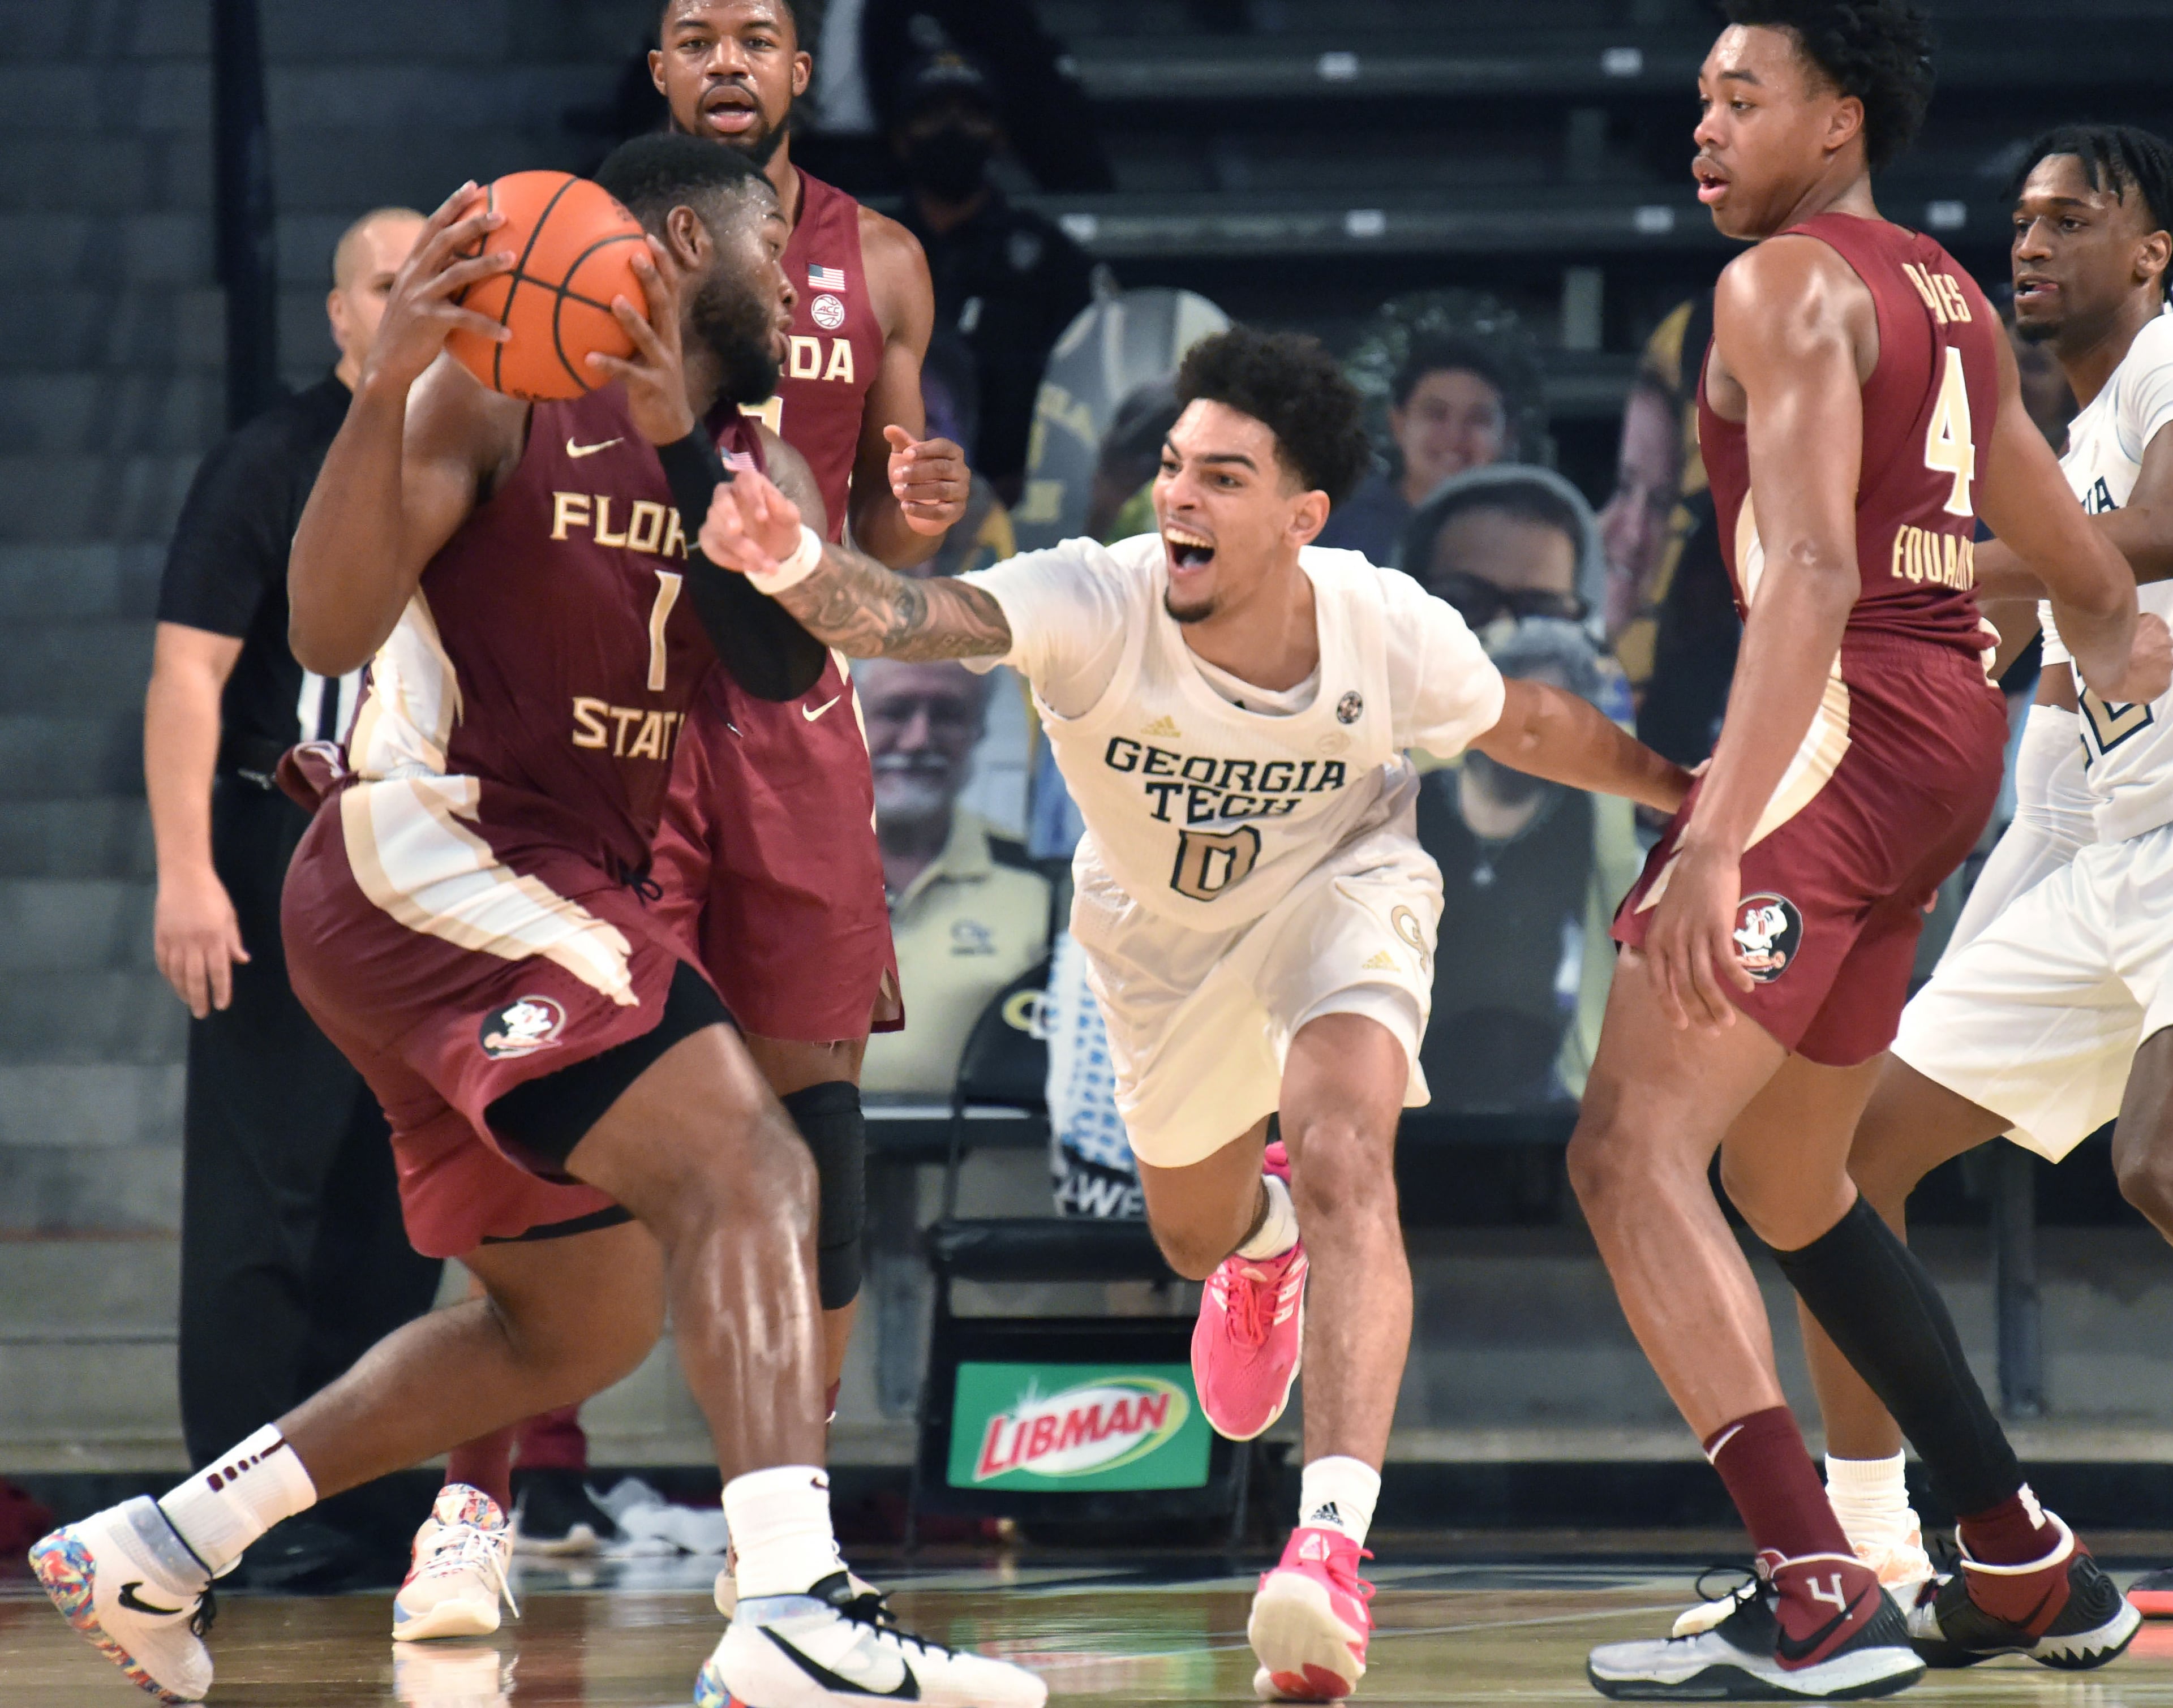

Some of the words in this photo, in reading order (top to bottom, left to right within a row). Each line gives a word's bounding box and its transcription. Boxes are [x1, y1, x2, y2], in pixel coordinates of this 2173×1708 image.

[817, 306, 840, 314] ACC
[1925, 346, 1975, 517] 4
[551, 491, 689, 561] FLOR
[647, 569, 682, 691] 1
[1105, 736, 1347, 793] GEORGIA
[1145, 782, 1302, 824] TECH
[1170, 824, 1261, 902] 0
[977, 1393, 1171, 1479] LIBMAN
